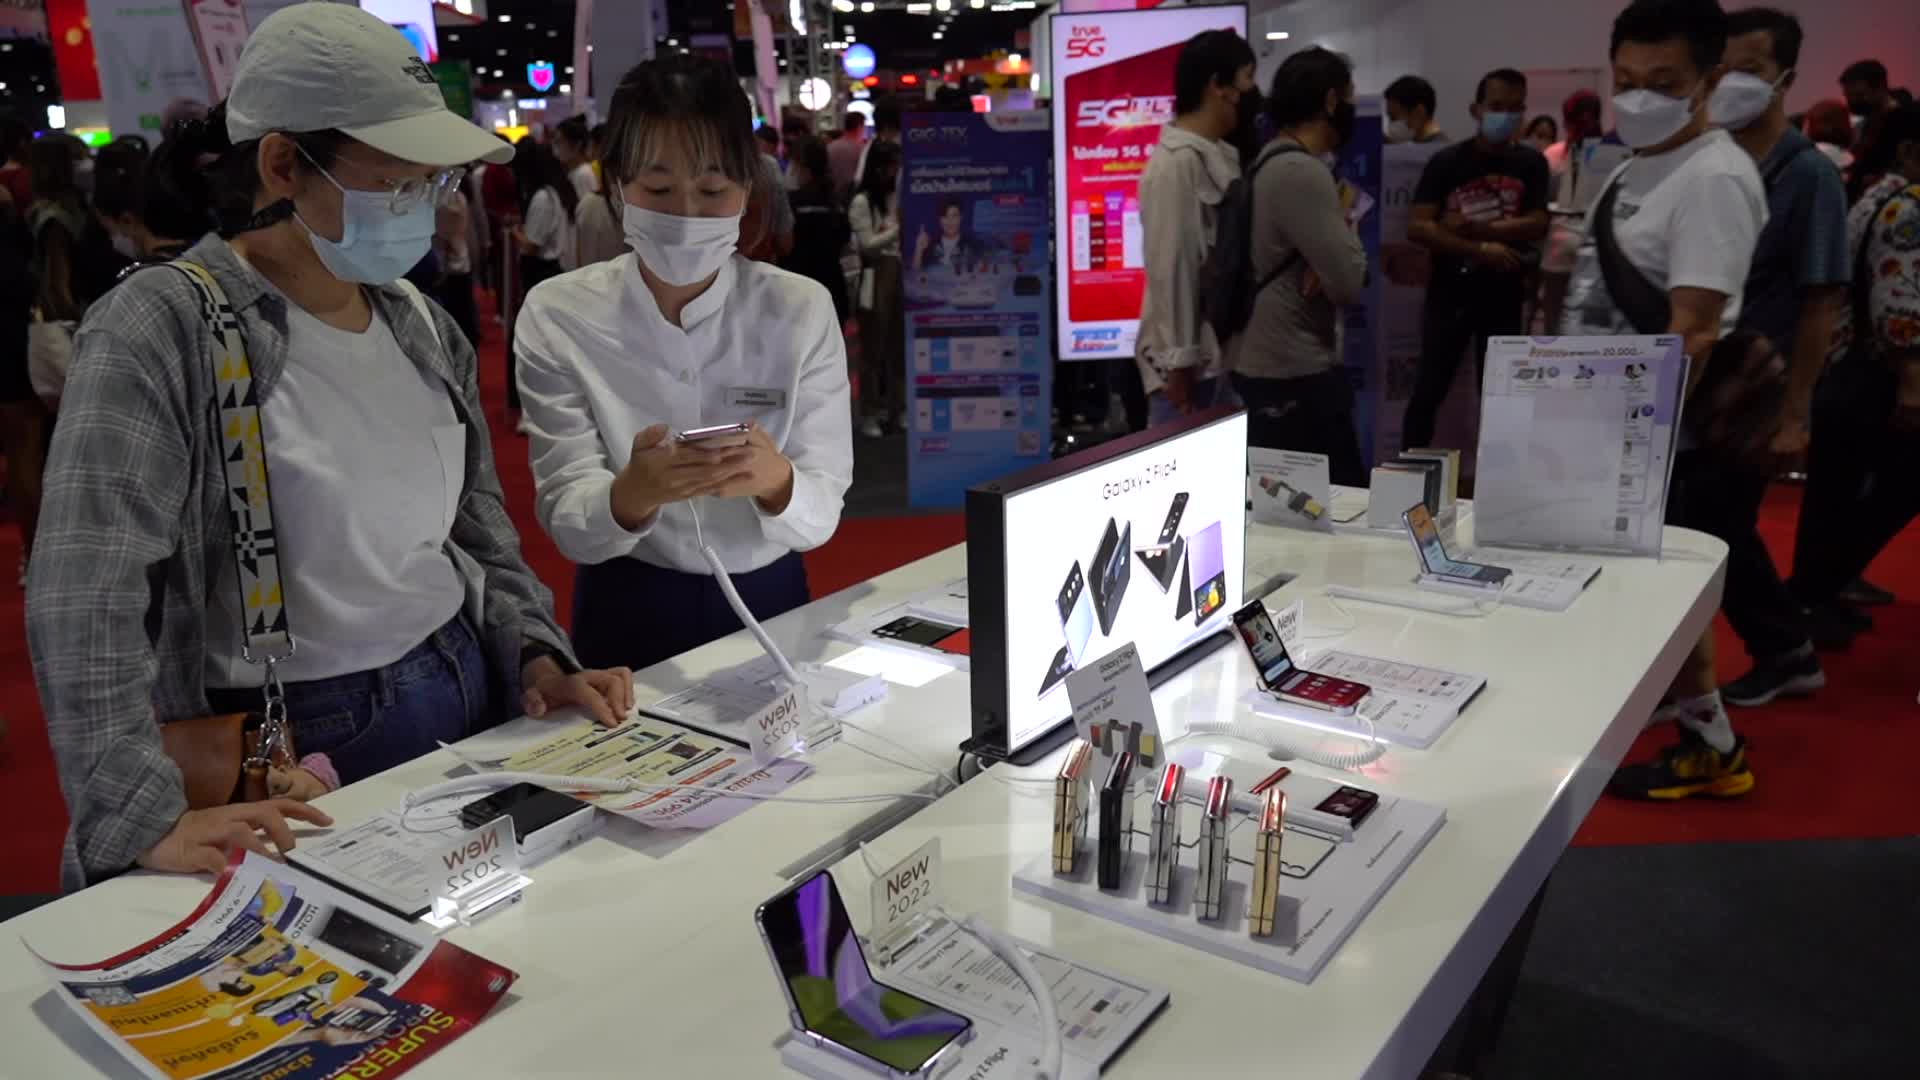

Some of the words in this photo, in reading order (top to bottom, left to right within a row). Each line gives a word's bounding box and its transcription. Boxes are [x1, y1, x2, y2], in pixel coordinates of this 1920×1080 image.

[1066, 37, 1106, 59] 5G
[1071, 26, 1101, 36] true
[1076, 97, 1132, 127] 5G
[1102, 474, 1143, 500] Galaxy
[1145, 467, 1151, 484] Z
[1153, 458, 1177, 480] Flip4
[887, 855, 929, 902] New
[887, 879, 929, 923] 2022
